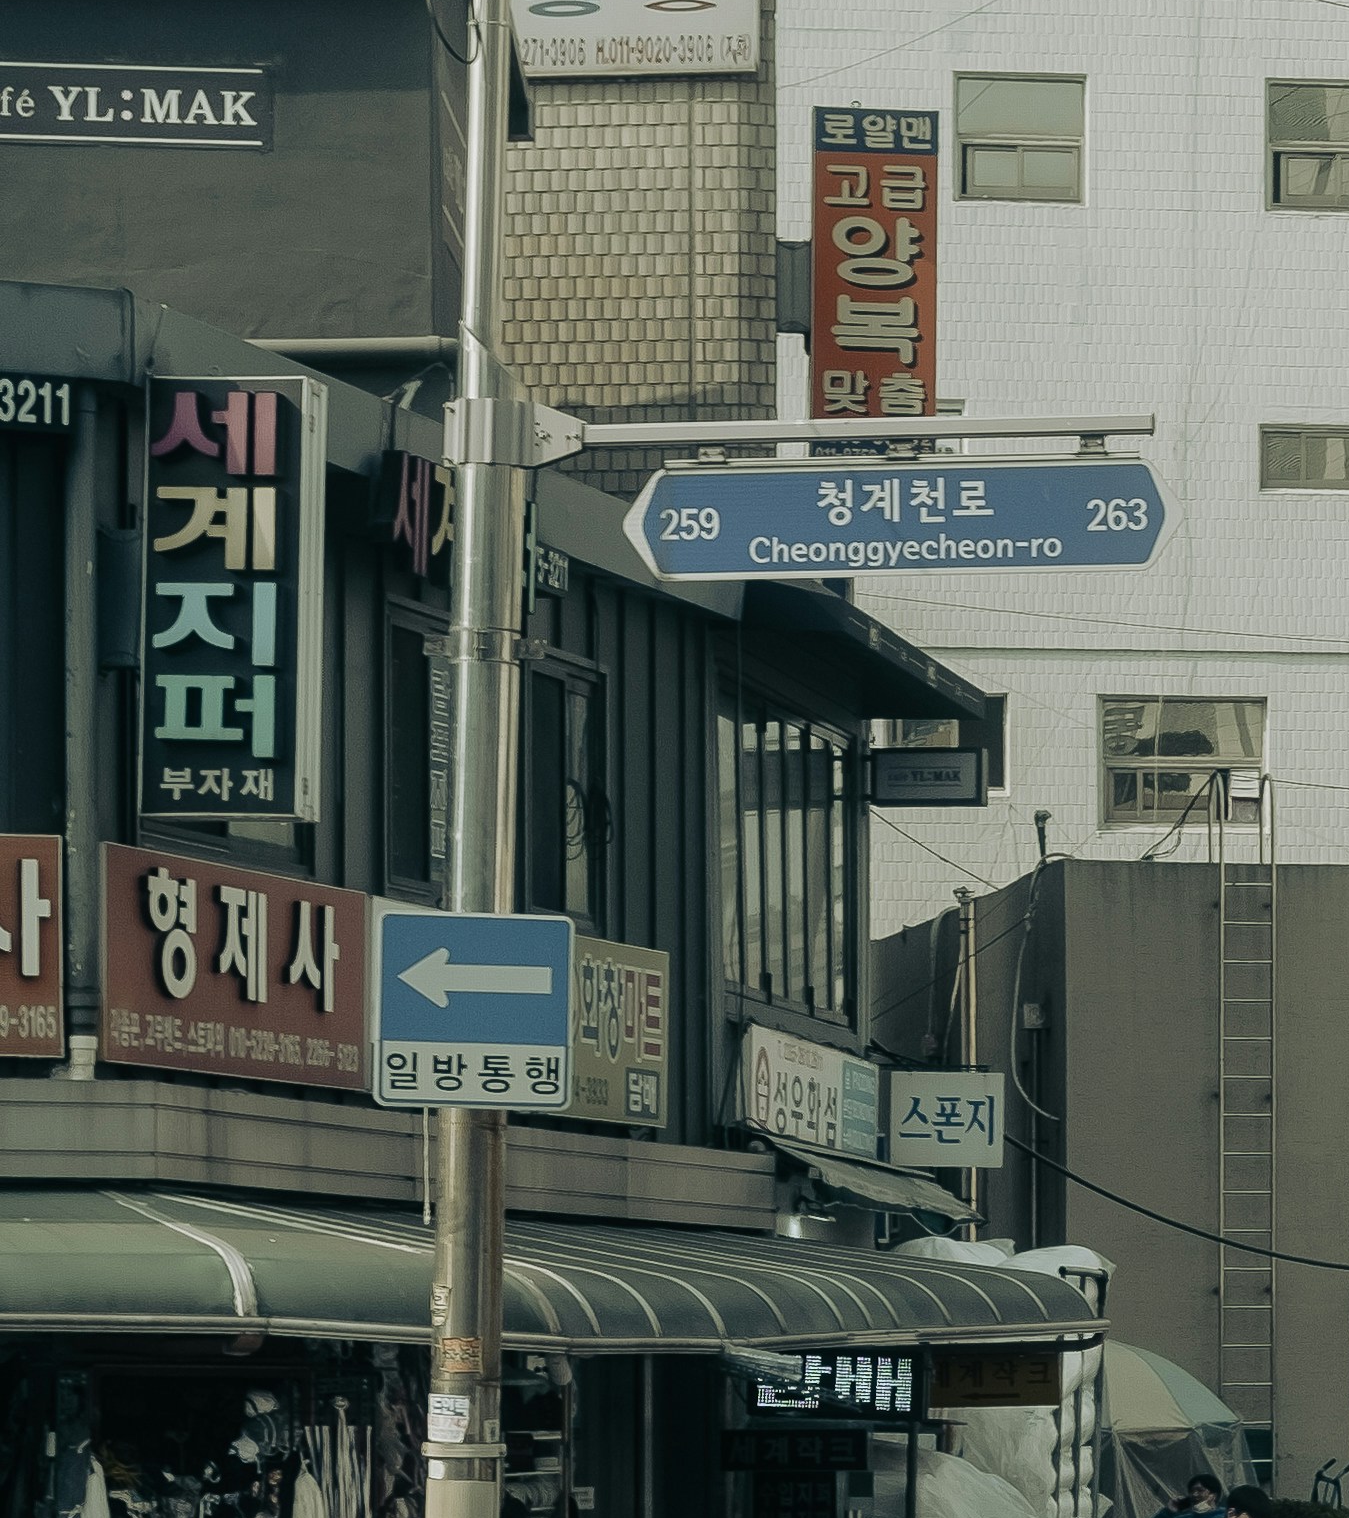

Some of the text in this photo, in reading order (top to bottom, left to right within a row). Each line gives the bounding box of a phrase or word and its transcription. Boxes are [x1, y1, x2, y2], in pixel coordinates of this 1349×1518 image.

[48, 84, 259, 127] YL:MAK
[822, 112, 934, 151] 로얄맨
[822, 162, 927, 212] 고급
[829, 214, 928, 366] 양복
[821, 368, 927, 416] 맞춤
[659, 478, 1149, 542] 259 청계천로 263
[747, 533, 1064, 568] Cheonggyecheon-ro
[151, 391, 279, 760] 세계지퍼
[159, 766, 275, 802] 부자재
[146, 865, 341, 1014] 형제사
[385, 1051, 561, 1097] 일방통행
[899, 1094, 996, 1147] 스폰지
